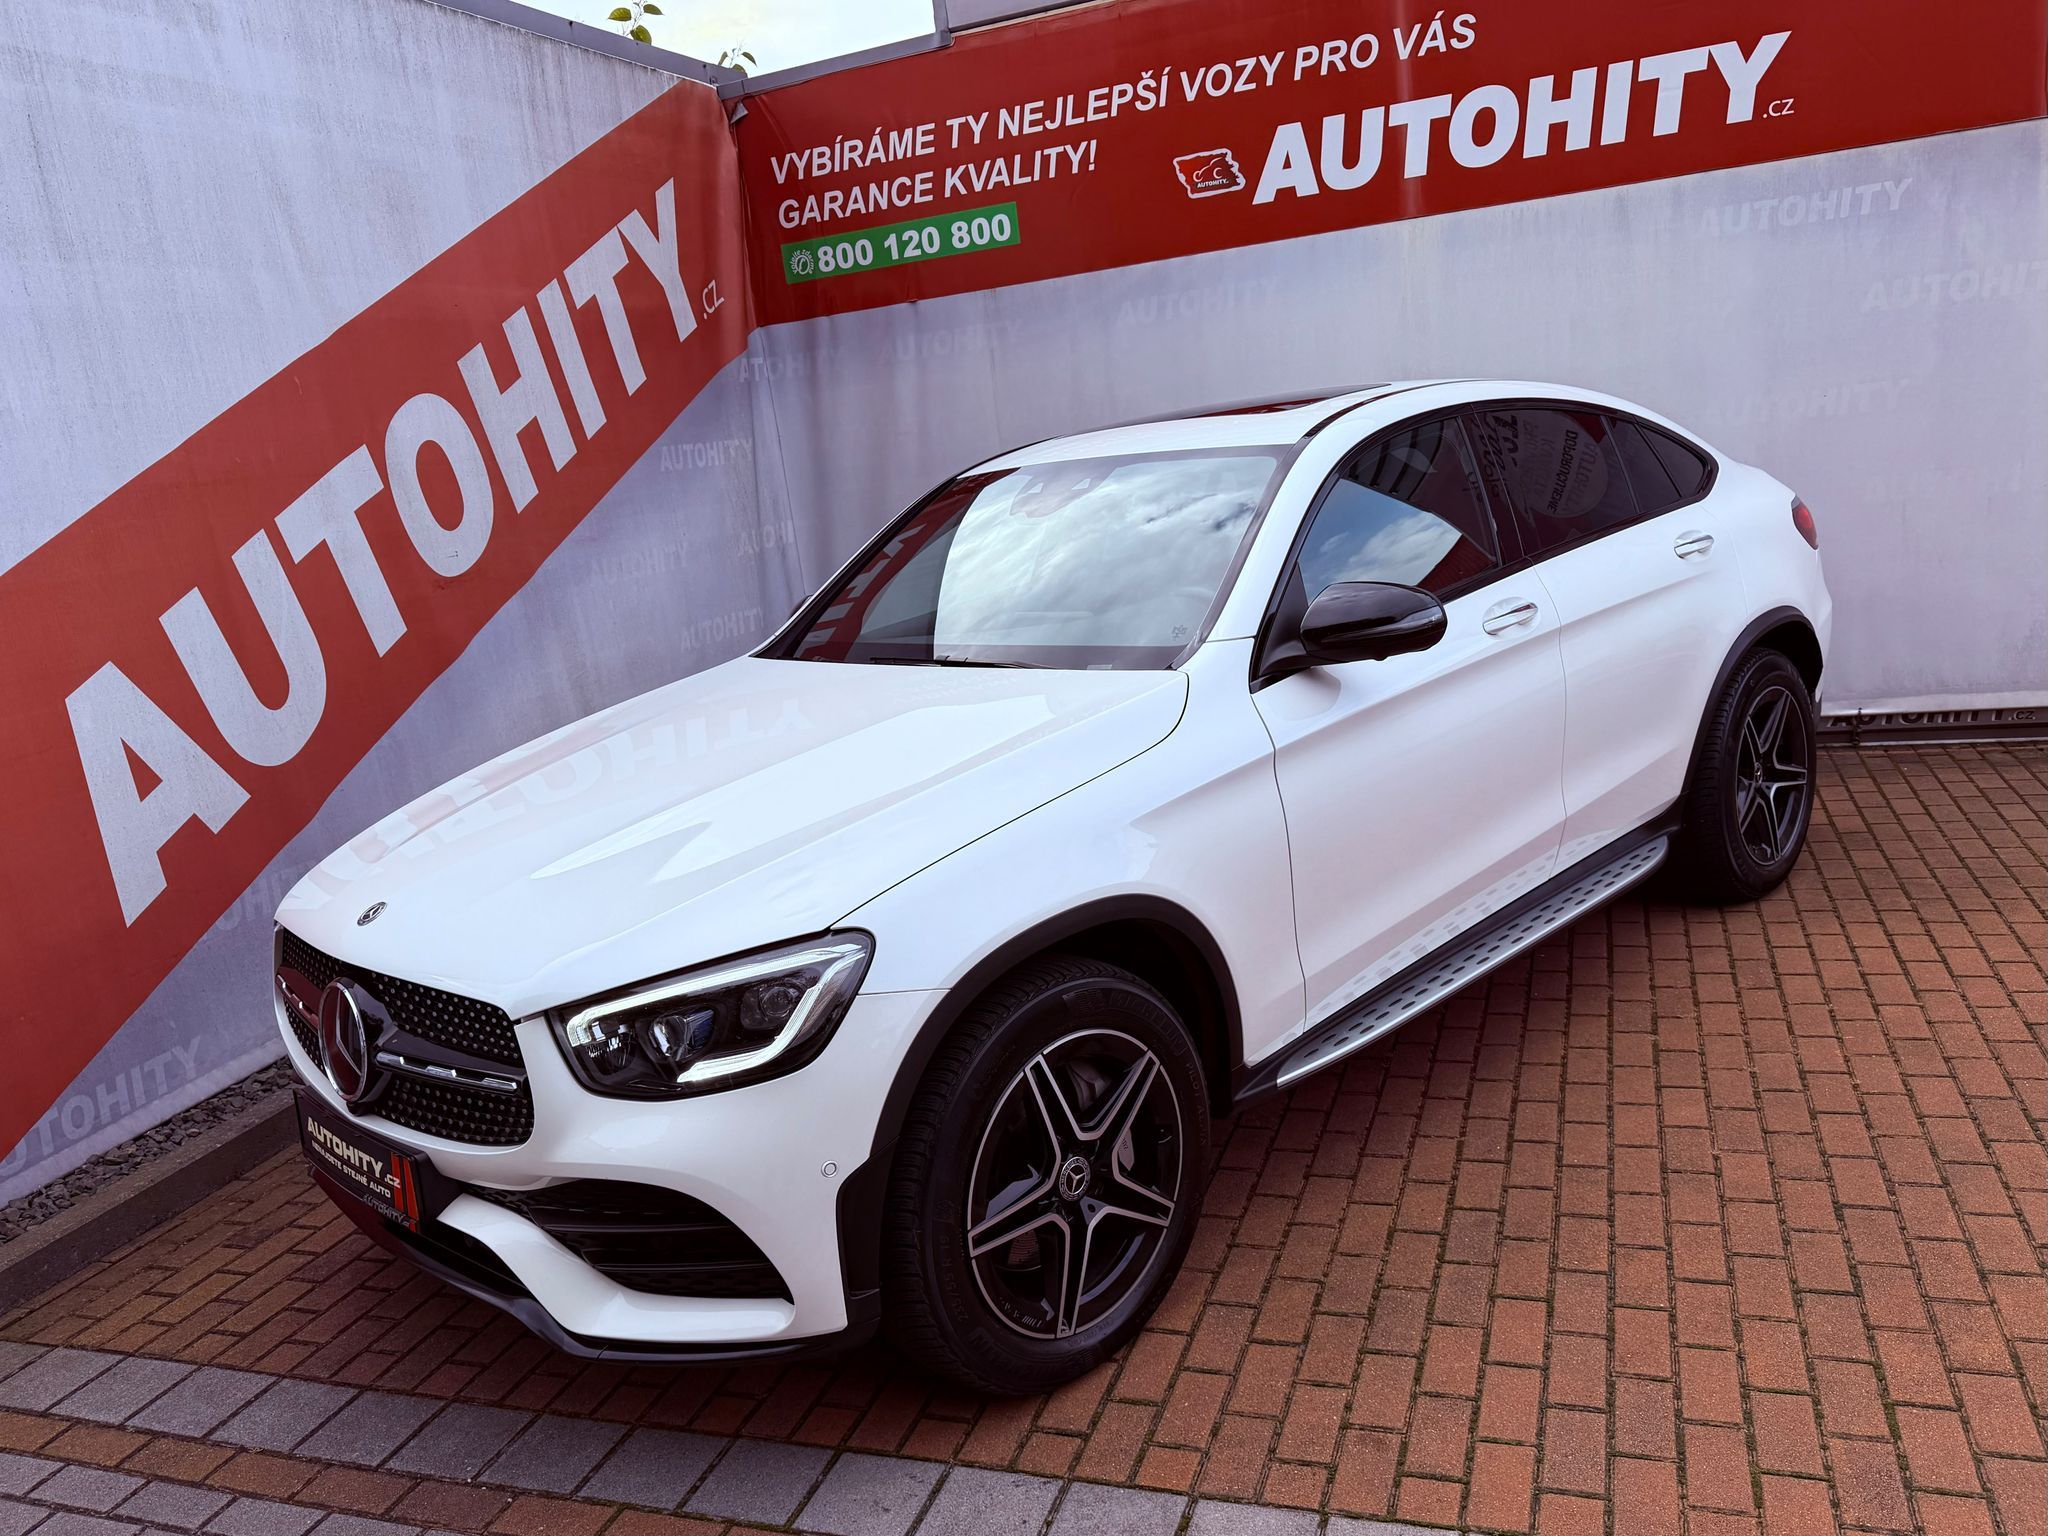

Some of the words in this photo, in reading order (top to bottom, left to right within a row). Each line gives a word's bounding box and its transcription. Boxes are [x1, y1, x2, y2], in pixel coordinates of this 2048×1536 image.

[770, 123, 936, 185] VYBÍRÁME
[946, 111, 989, 149] TY
[997, 66, 1172, 140] NEJLEPŠÍ
[1179, 51, 1285, 102] VOZY
[1293, 33, 1380, 81] PRO
[1392, 10, 1477, 61] VÁS
[778, 171, 934, 229] GARANCE
[944, 139, 1098, 199] KVALITY!
[818, 245, 874, 273] 800
[884, 226, 940, 260] 120
[950, 213, 1012, 249] 800
[369, 1181, 391, 1199] AUTO
